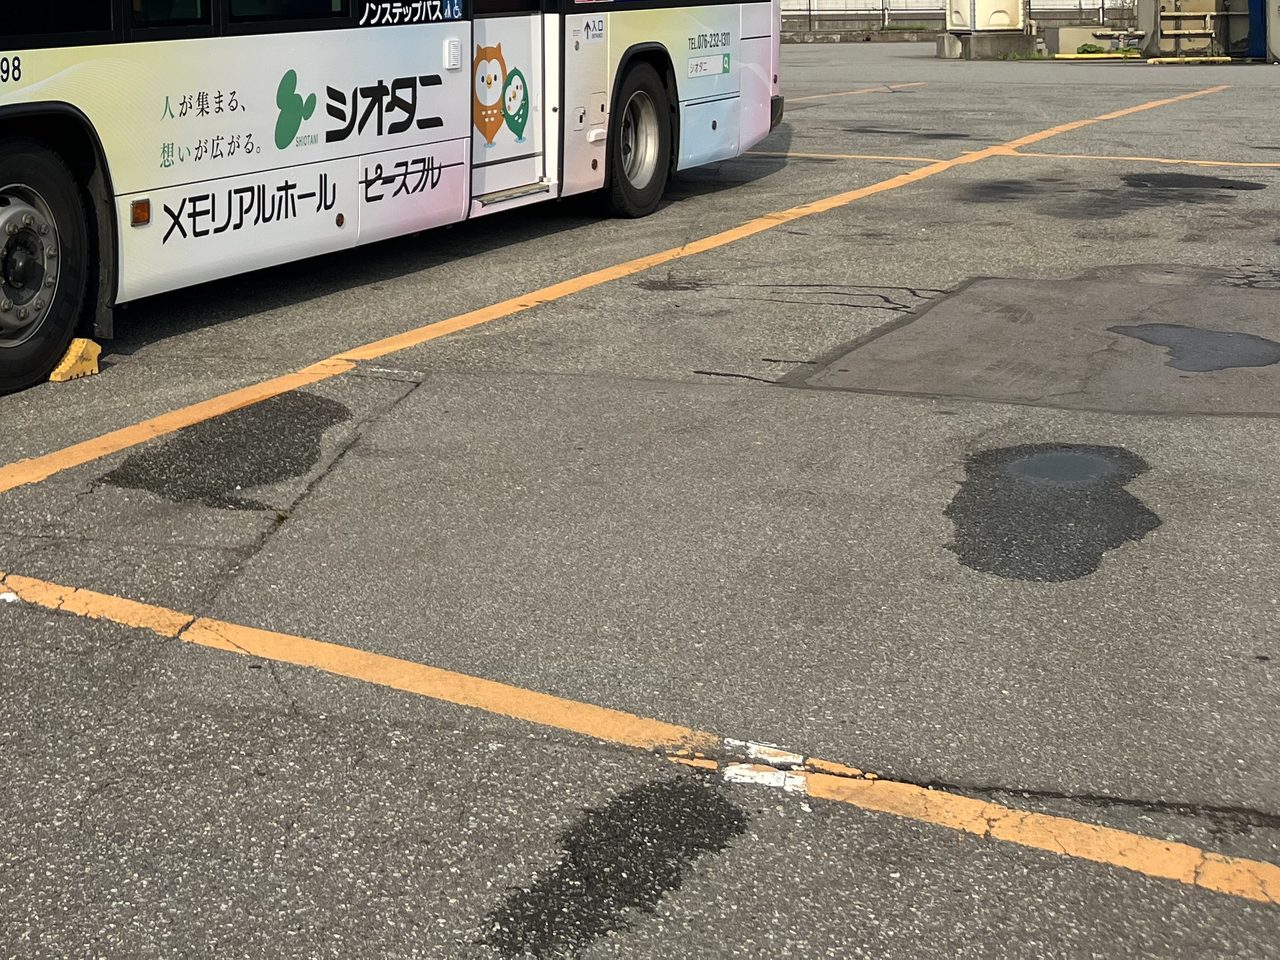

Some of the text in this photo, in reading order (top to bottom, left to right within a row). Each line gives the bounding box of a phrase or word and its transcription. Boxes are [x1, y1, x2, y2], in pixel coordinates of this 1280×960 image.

[359, 0, 443, 25] ノンステップバス
[591, 20, 604, 32] 入口
[160, 90, 246, 121] 人が集まる、
[325, 74, 444, 143] シオタニ
[160, 133, 261, 168] 想いが広がる。
[363, 156, 442, 203] ピースフル
[163, 173, 336, 245] メモリアルホール
